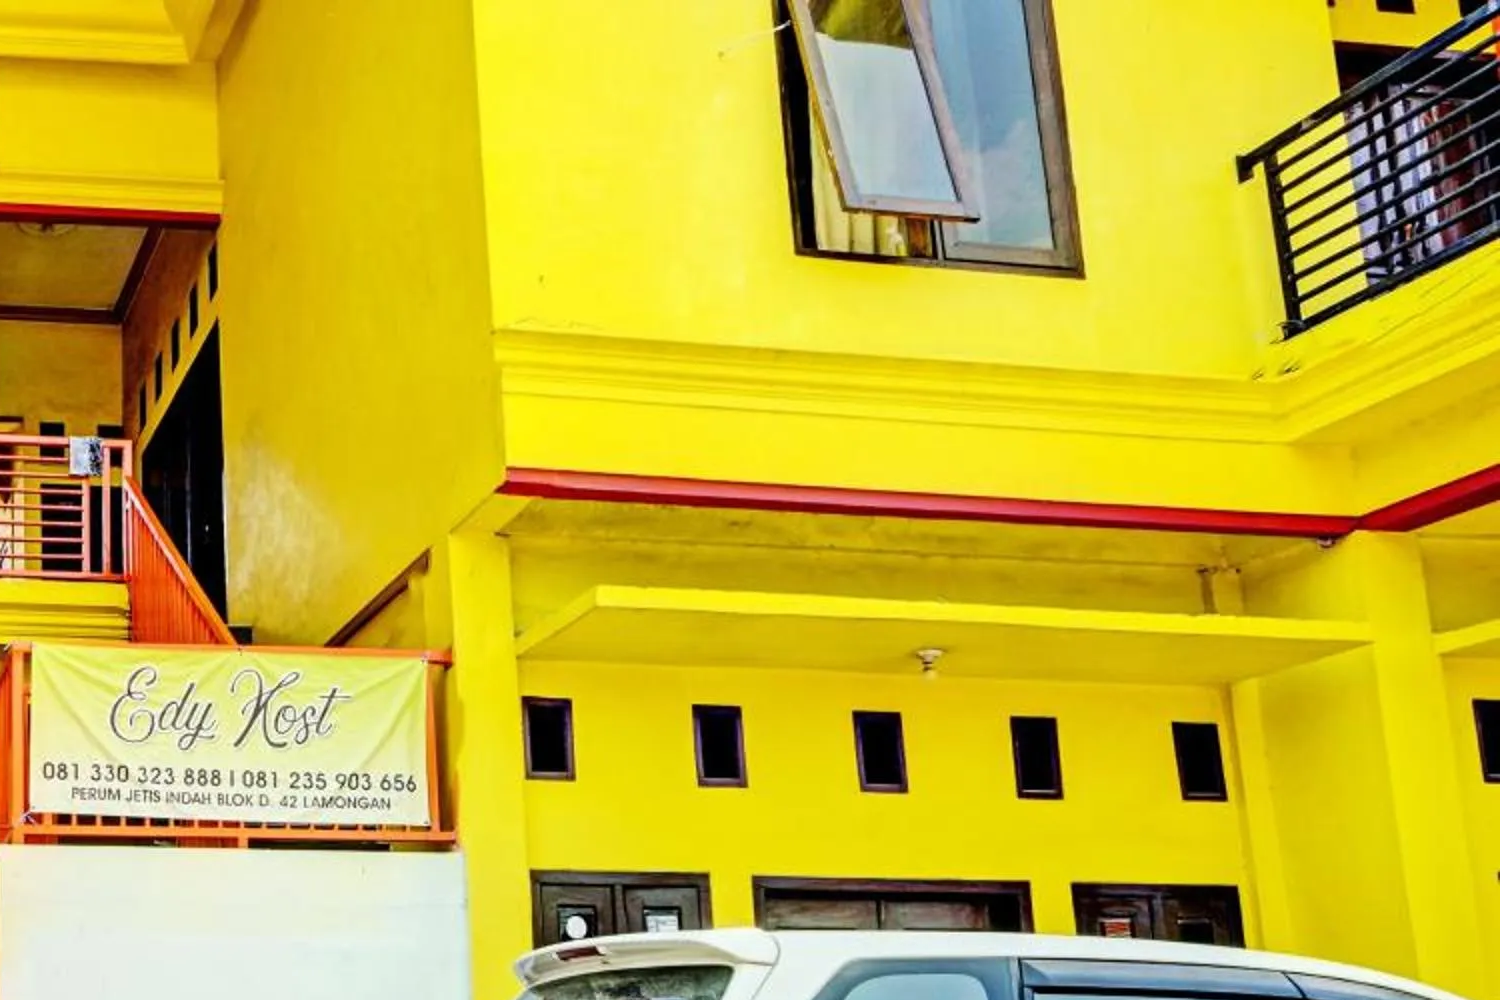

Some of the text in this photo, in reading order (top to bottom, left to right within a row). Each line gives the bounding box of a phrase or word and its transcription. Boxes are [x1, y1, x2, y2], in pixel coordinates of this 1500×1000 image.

[109, 666, 352, 751] Edy Kost
[42, 761, 80, 781] 081
[90, 763, 130, 783] 330
[137, 766, 175, 786] 323
[183, 767, 222, 787] 888
[241, 769, 278, 789] 081
[289, 771, 328, 791] 235
[335, 772, 373, 791] 903
[379, 773, 417, 793] 656
[71, 787, 121, 801] PERUM
[125, 788, 162, 804] JETIS
[165, 791, 212, 805] INDAH
[217, 792, 254, 807] BLOK
[279, 795, 298, 809] 42
[303, 795, 391, 810] LAMONGAN
